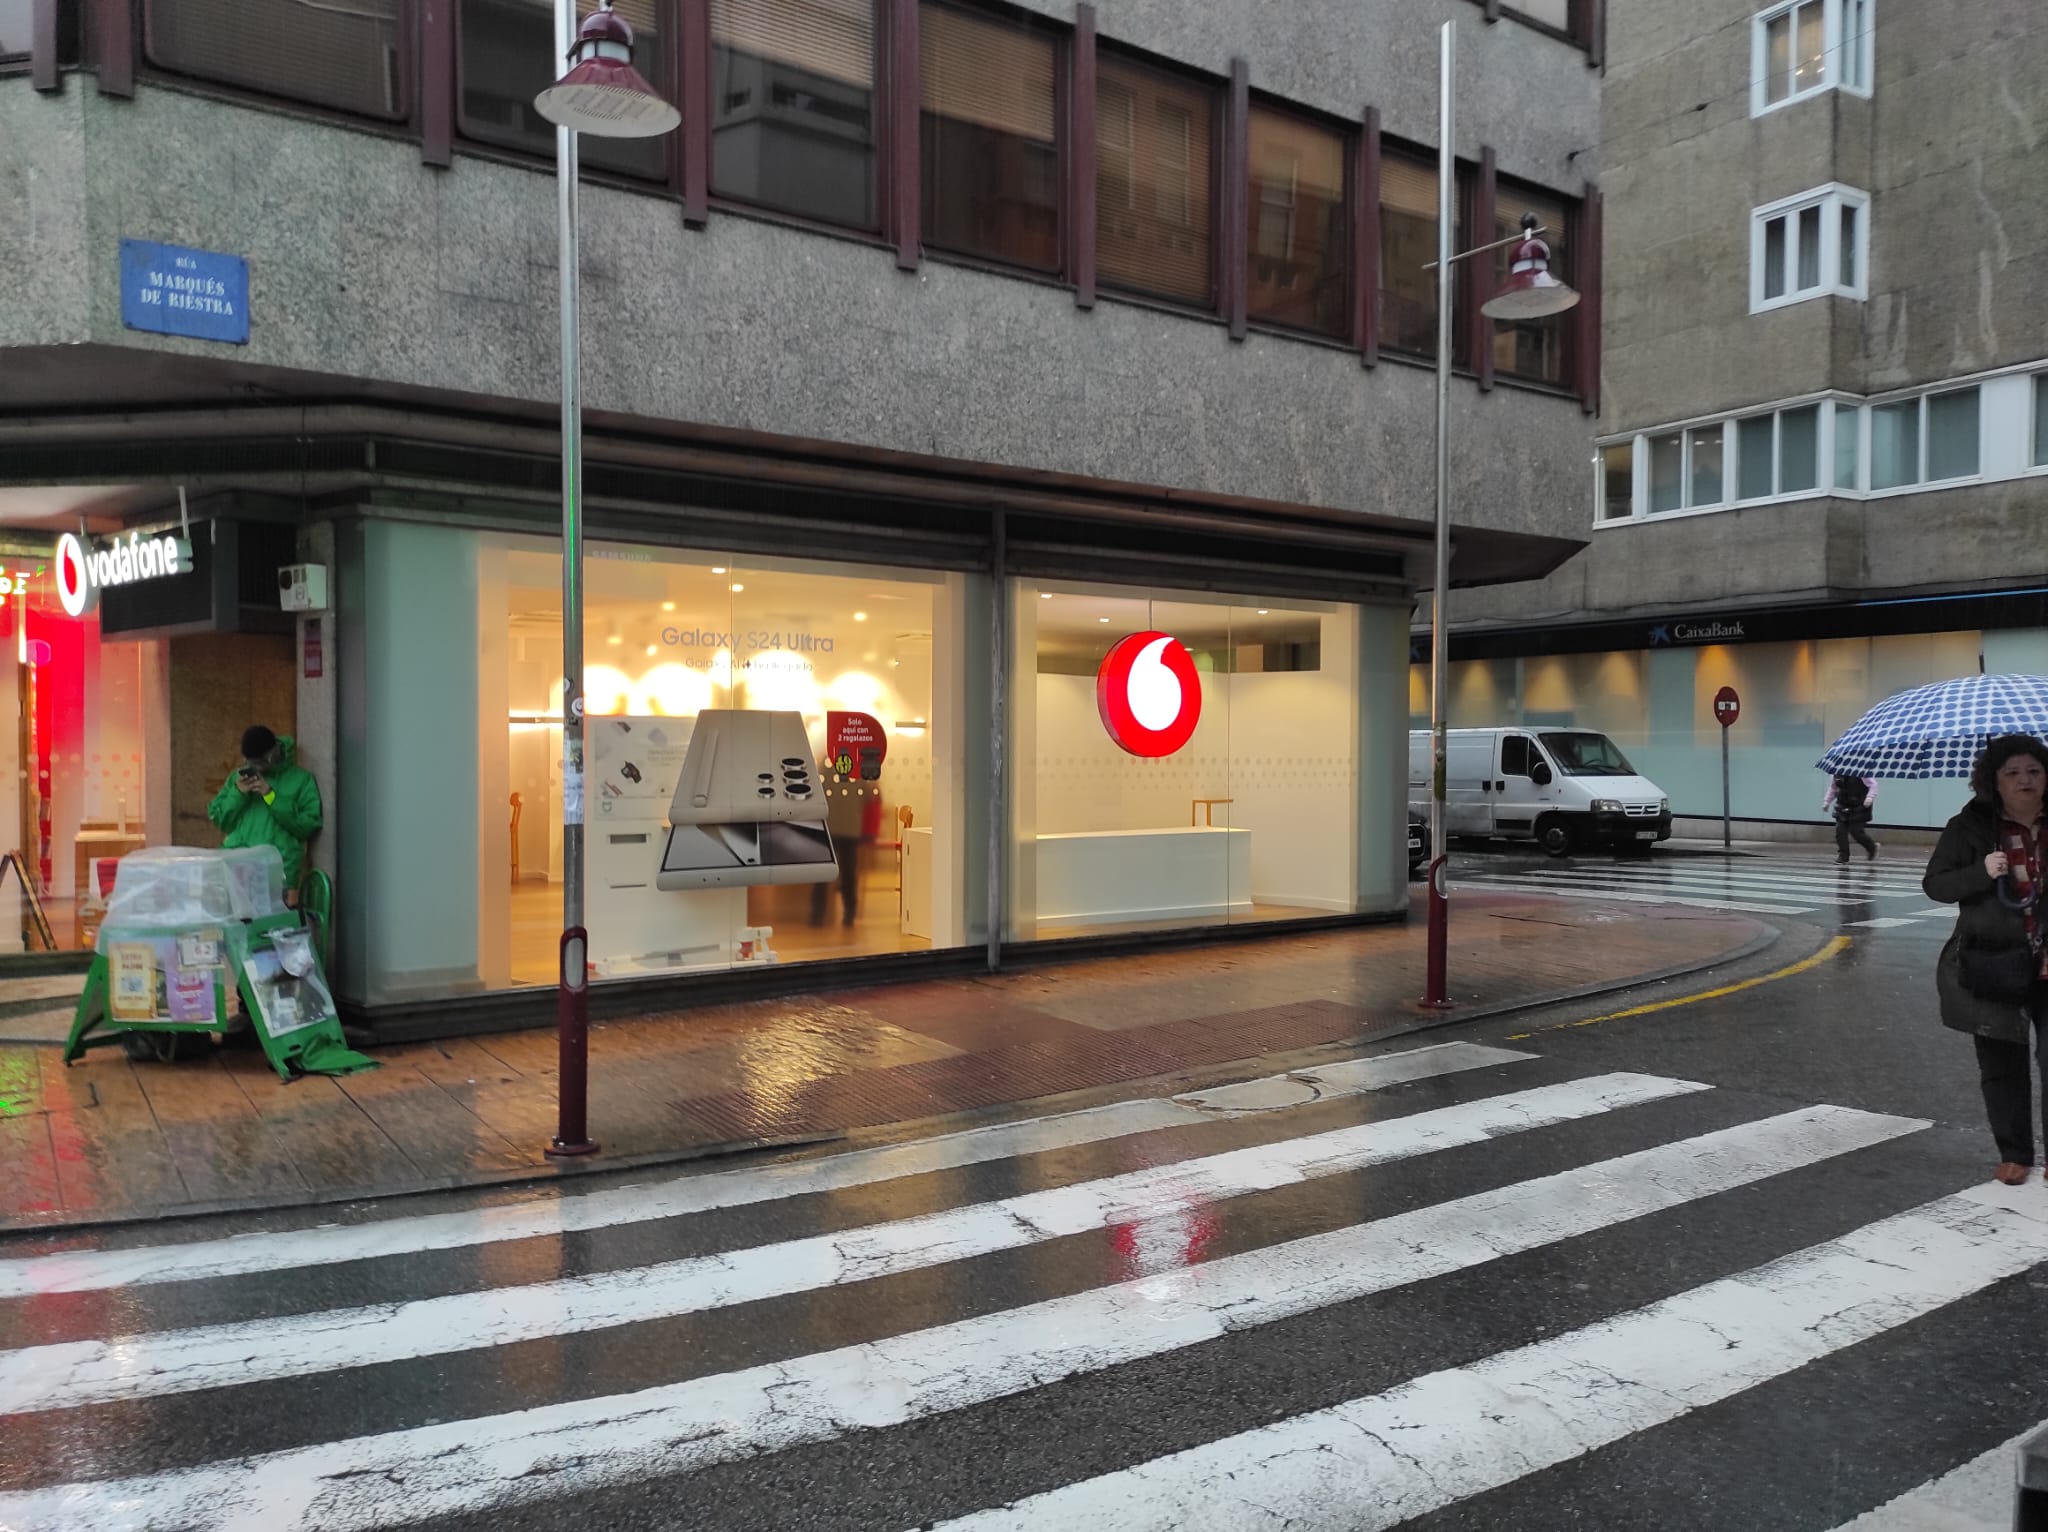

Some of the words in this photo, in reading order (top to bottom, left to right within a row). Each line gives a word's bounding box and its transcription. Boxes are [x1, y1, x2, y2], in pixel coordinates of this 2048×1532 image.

[176, 257, 197, 270] RÚA
[150, 271, 225, 297] MARQUÉS
[140, 288, 162, 305] DE
[168, 292, 234, 316] RIESTRA
[86, 531, 178, 588] vodafone
[1674, 621, 1745, 639] CaixaBank
[661, 626, 742, 654] Galaxy
[746, 631, 782, 650] S24
[787, 632, 834, 653] Ultra
[685, 657, 726, 669] Galax
[842, 726, 856, 735] aquí
[848, 717, 863, 726] Solo
